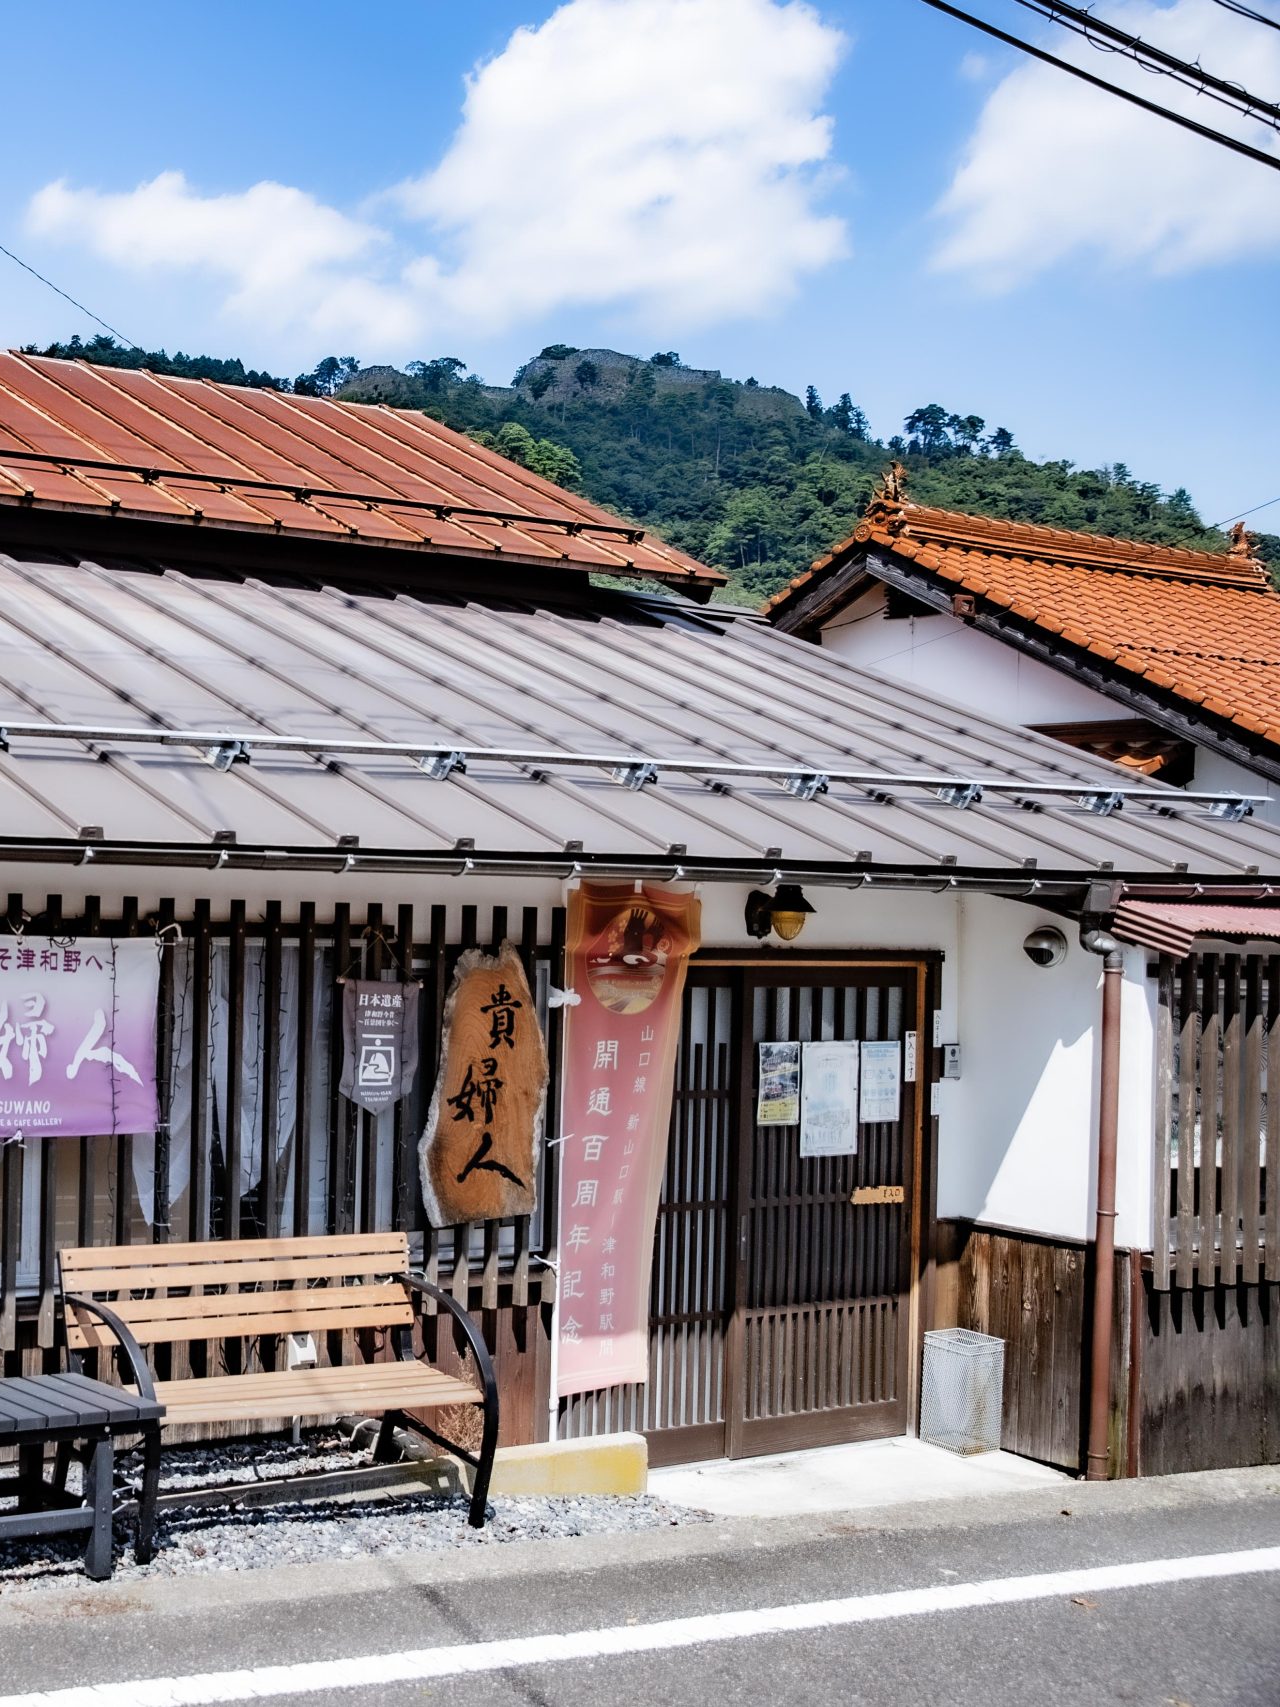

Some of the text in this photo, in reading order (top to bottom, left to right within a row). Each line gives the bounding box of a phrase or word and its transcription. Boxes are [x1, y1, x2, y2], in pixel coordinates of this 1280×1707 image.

[358, 993, 403, 1008] 日本遺産
[446, 984, 527, 1189] 貴婦人
[633, 1025, 654, 1094] 山口線
[14, 1118, 31, 1127] CAFE
[33, 1117, 63, 1126] GALLERY
[561, 1039, 619, 1345] 開通百周年記念
